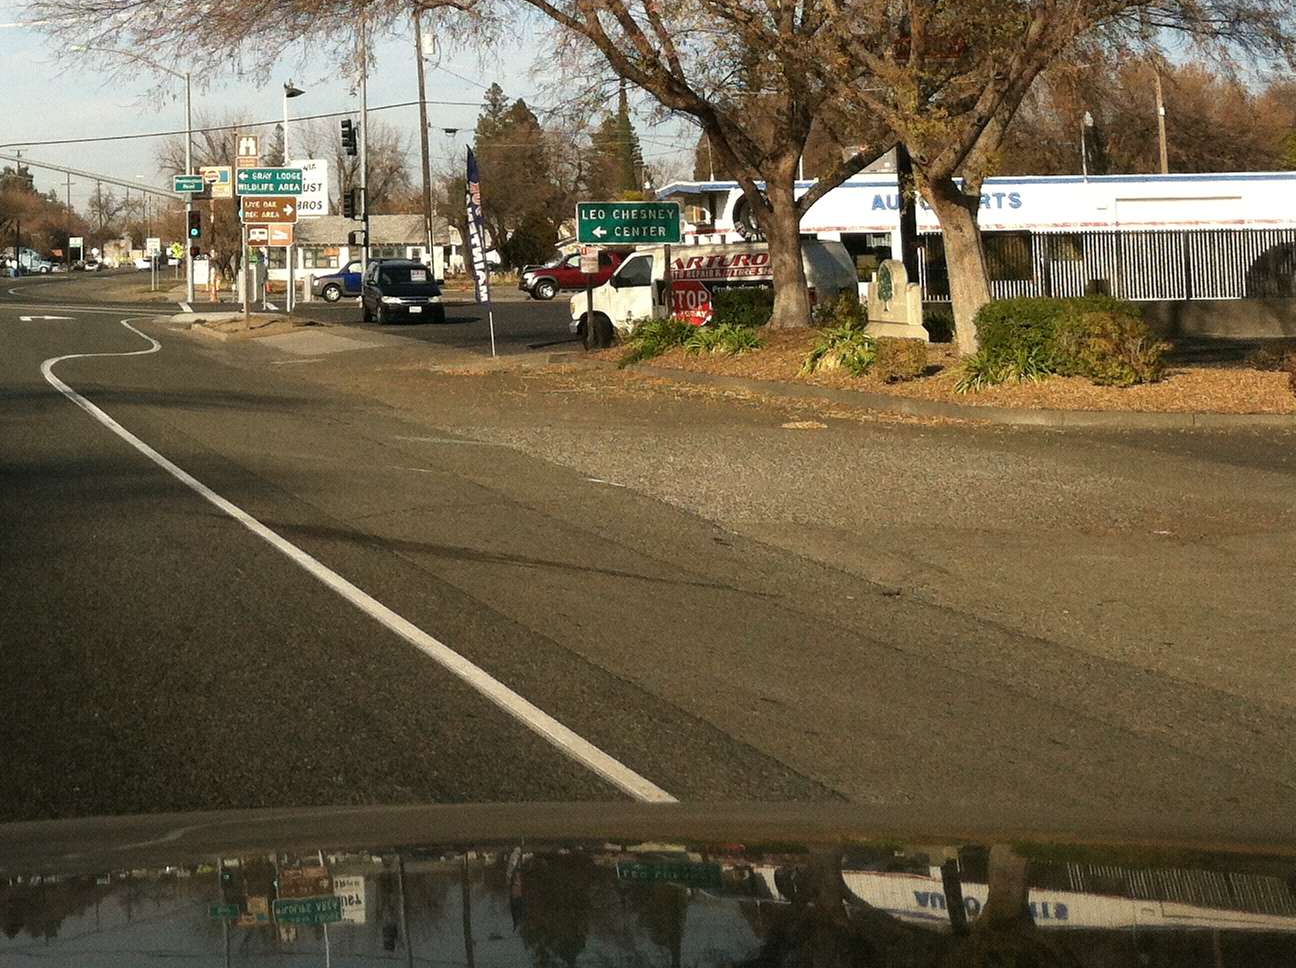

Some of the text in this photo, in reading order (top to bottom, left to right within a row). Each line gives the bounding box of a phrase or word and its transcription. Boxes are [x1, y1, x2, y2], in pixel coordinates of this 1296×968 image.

[251, 172, 301, 181] GRAY LODGE
[238, 182, 275, 192] WILDLIFE
[277, 182, 301, 192] AREA
[581, 208, 674, 220] LEO CHESNEY
[614, 225, 666, 237] CENTER
